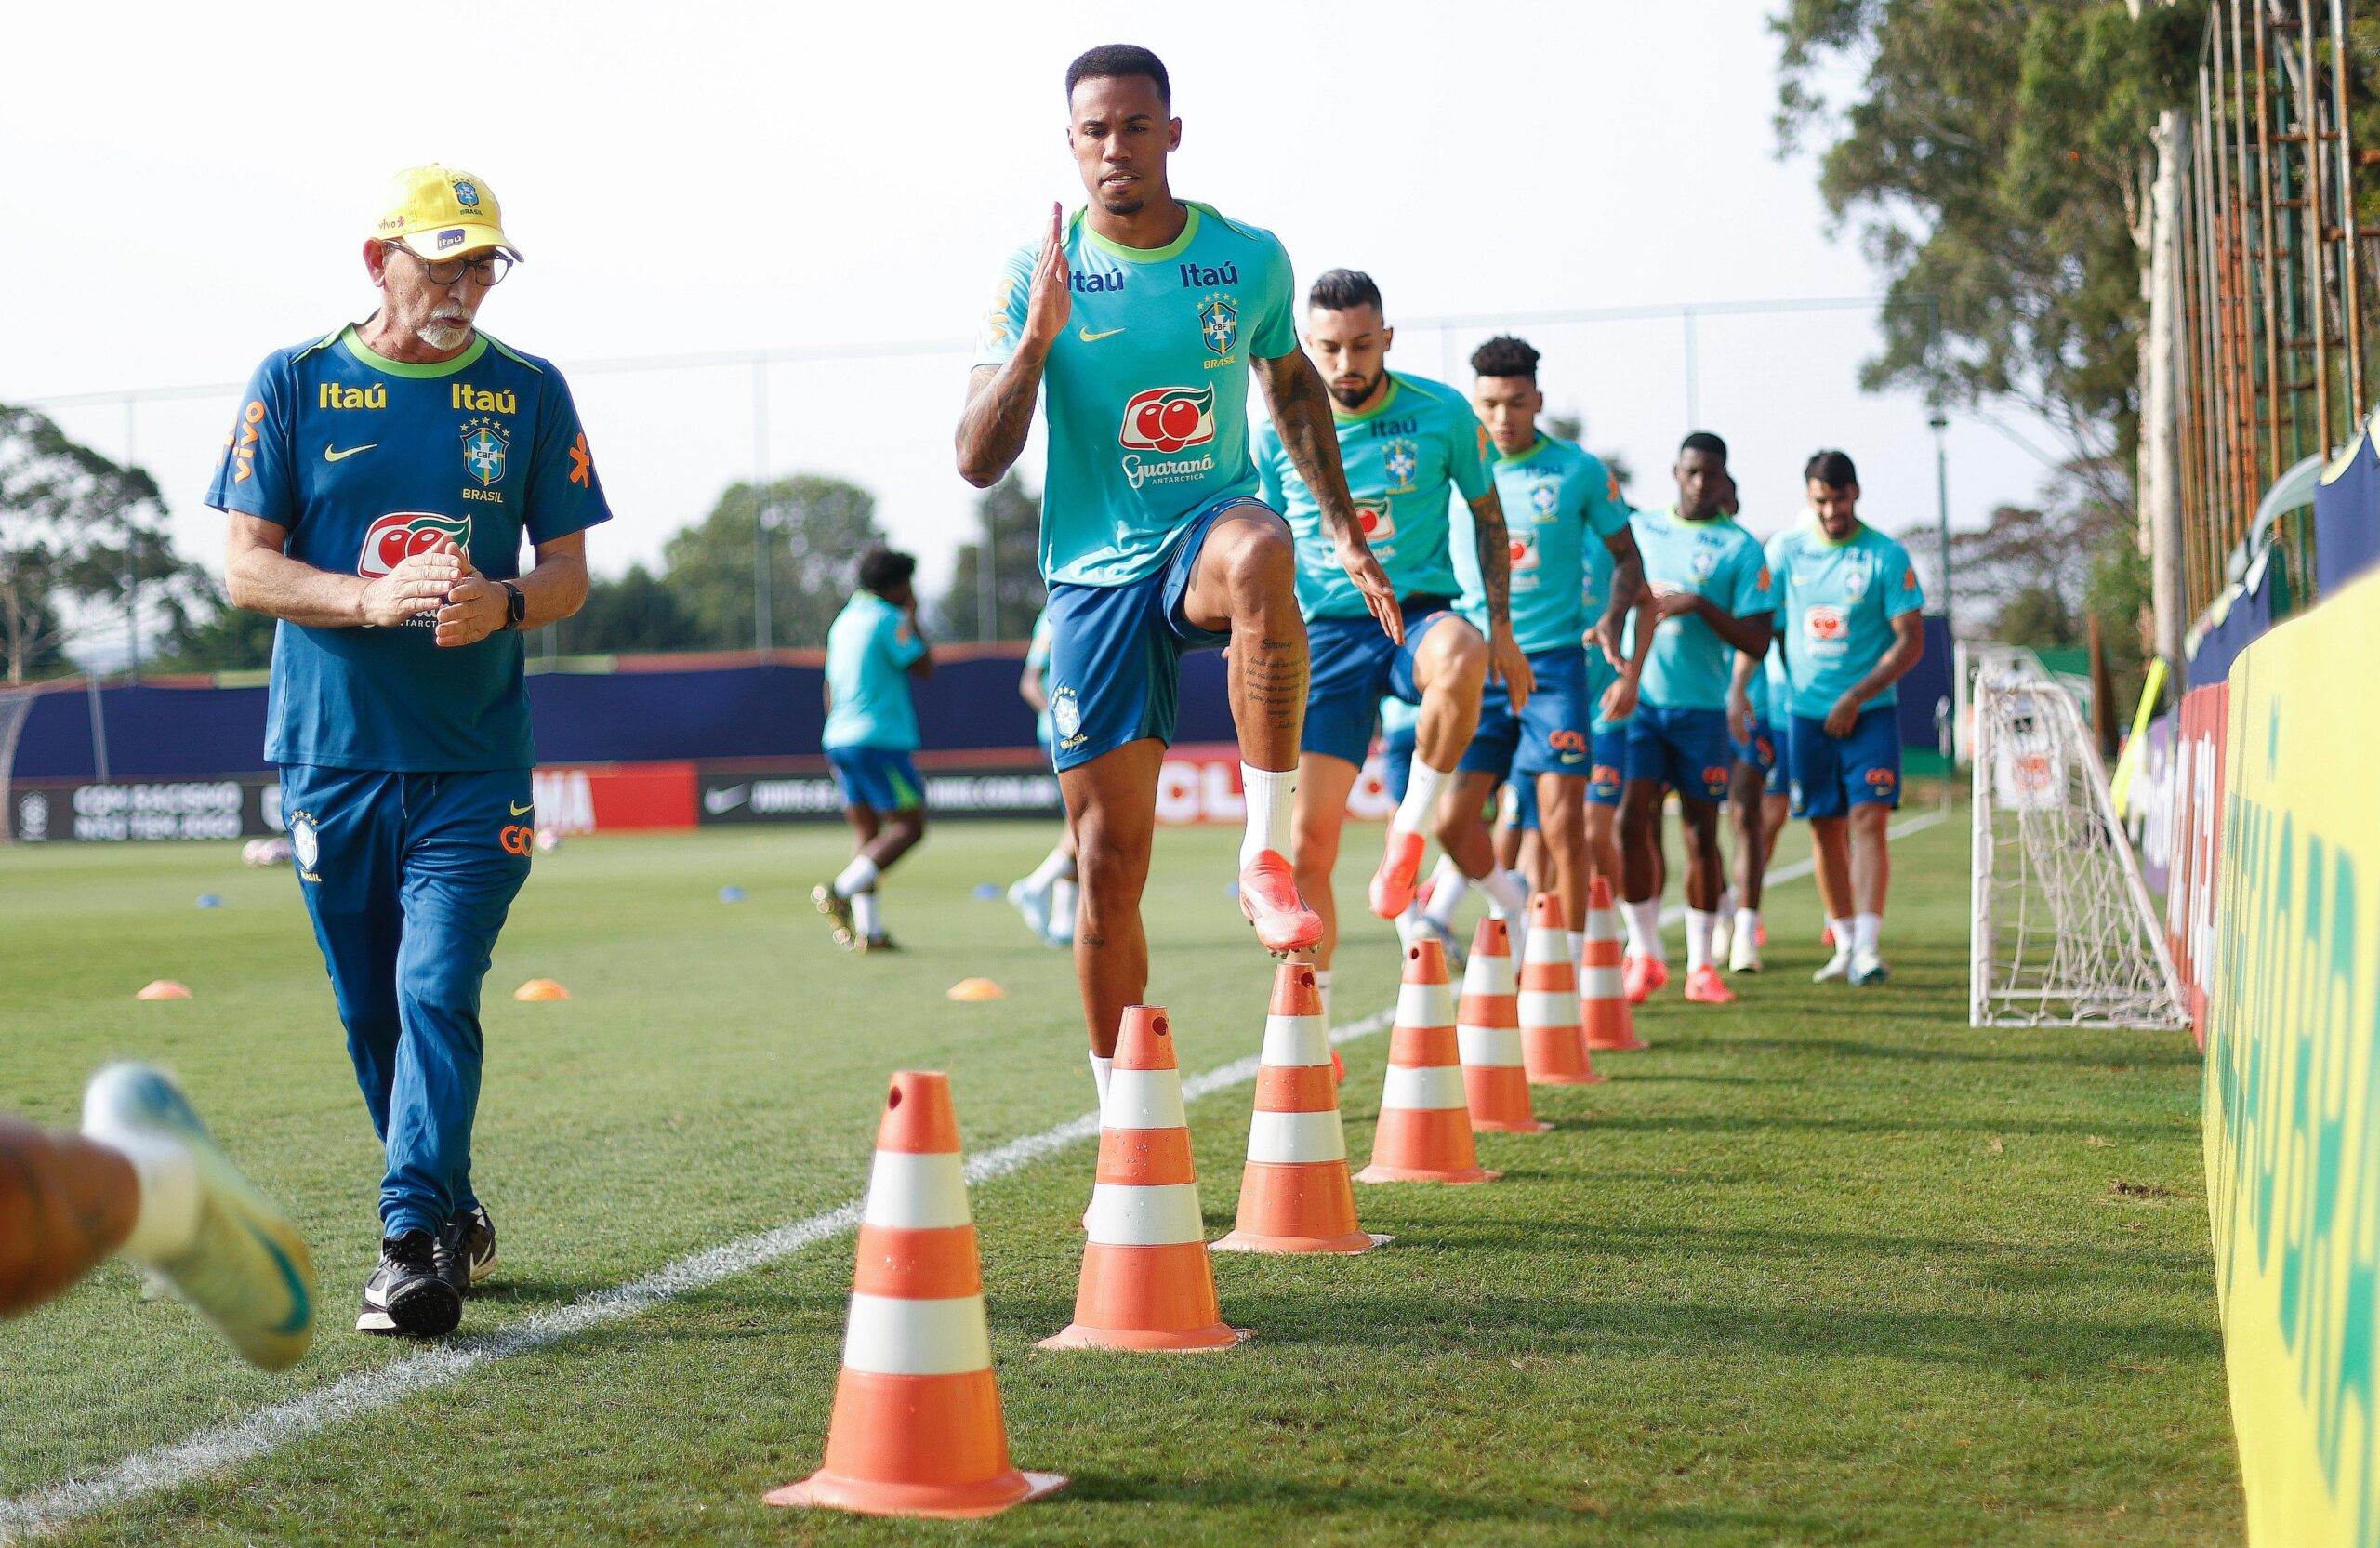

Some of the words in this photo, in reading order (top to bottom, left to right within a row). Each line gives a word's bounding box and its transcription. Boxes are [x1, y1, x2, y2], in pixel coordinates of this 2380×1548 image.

[439, 235, 462, 246] Itaú
[1179, 260, 1238, 288] Itaú
[1203, 356, 1236, 369] BRASIL
[319, 382, 387, 409] Itaú
[452, 383, 516, 414] Itaú
[1371, 417, 1417, 437] Itaú
[234, 401, 265, 483] vivo
[476, 451, 494, 459] CBF
[1121, 453, 1215, 489] Guaraná
[1152, 473, 1205, 484] ANTARCTICA
[462, 488, 503, 503] BRASIL
[1060, 734, 1088, 749] BRASIL
[500, 826, 534, 857] GO
